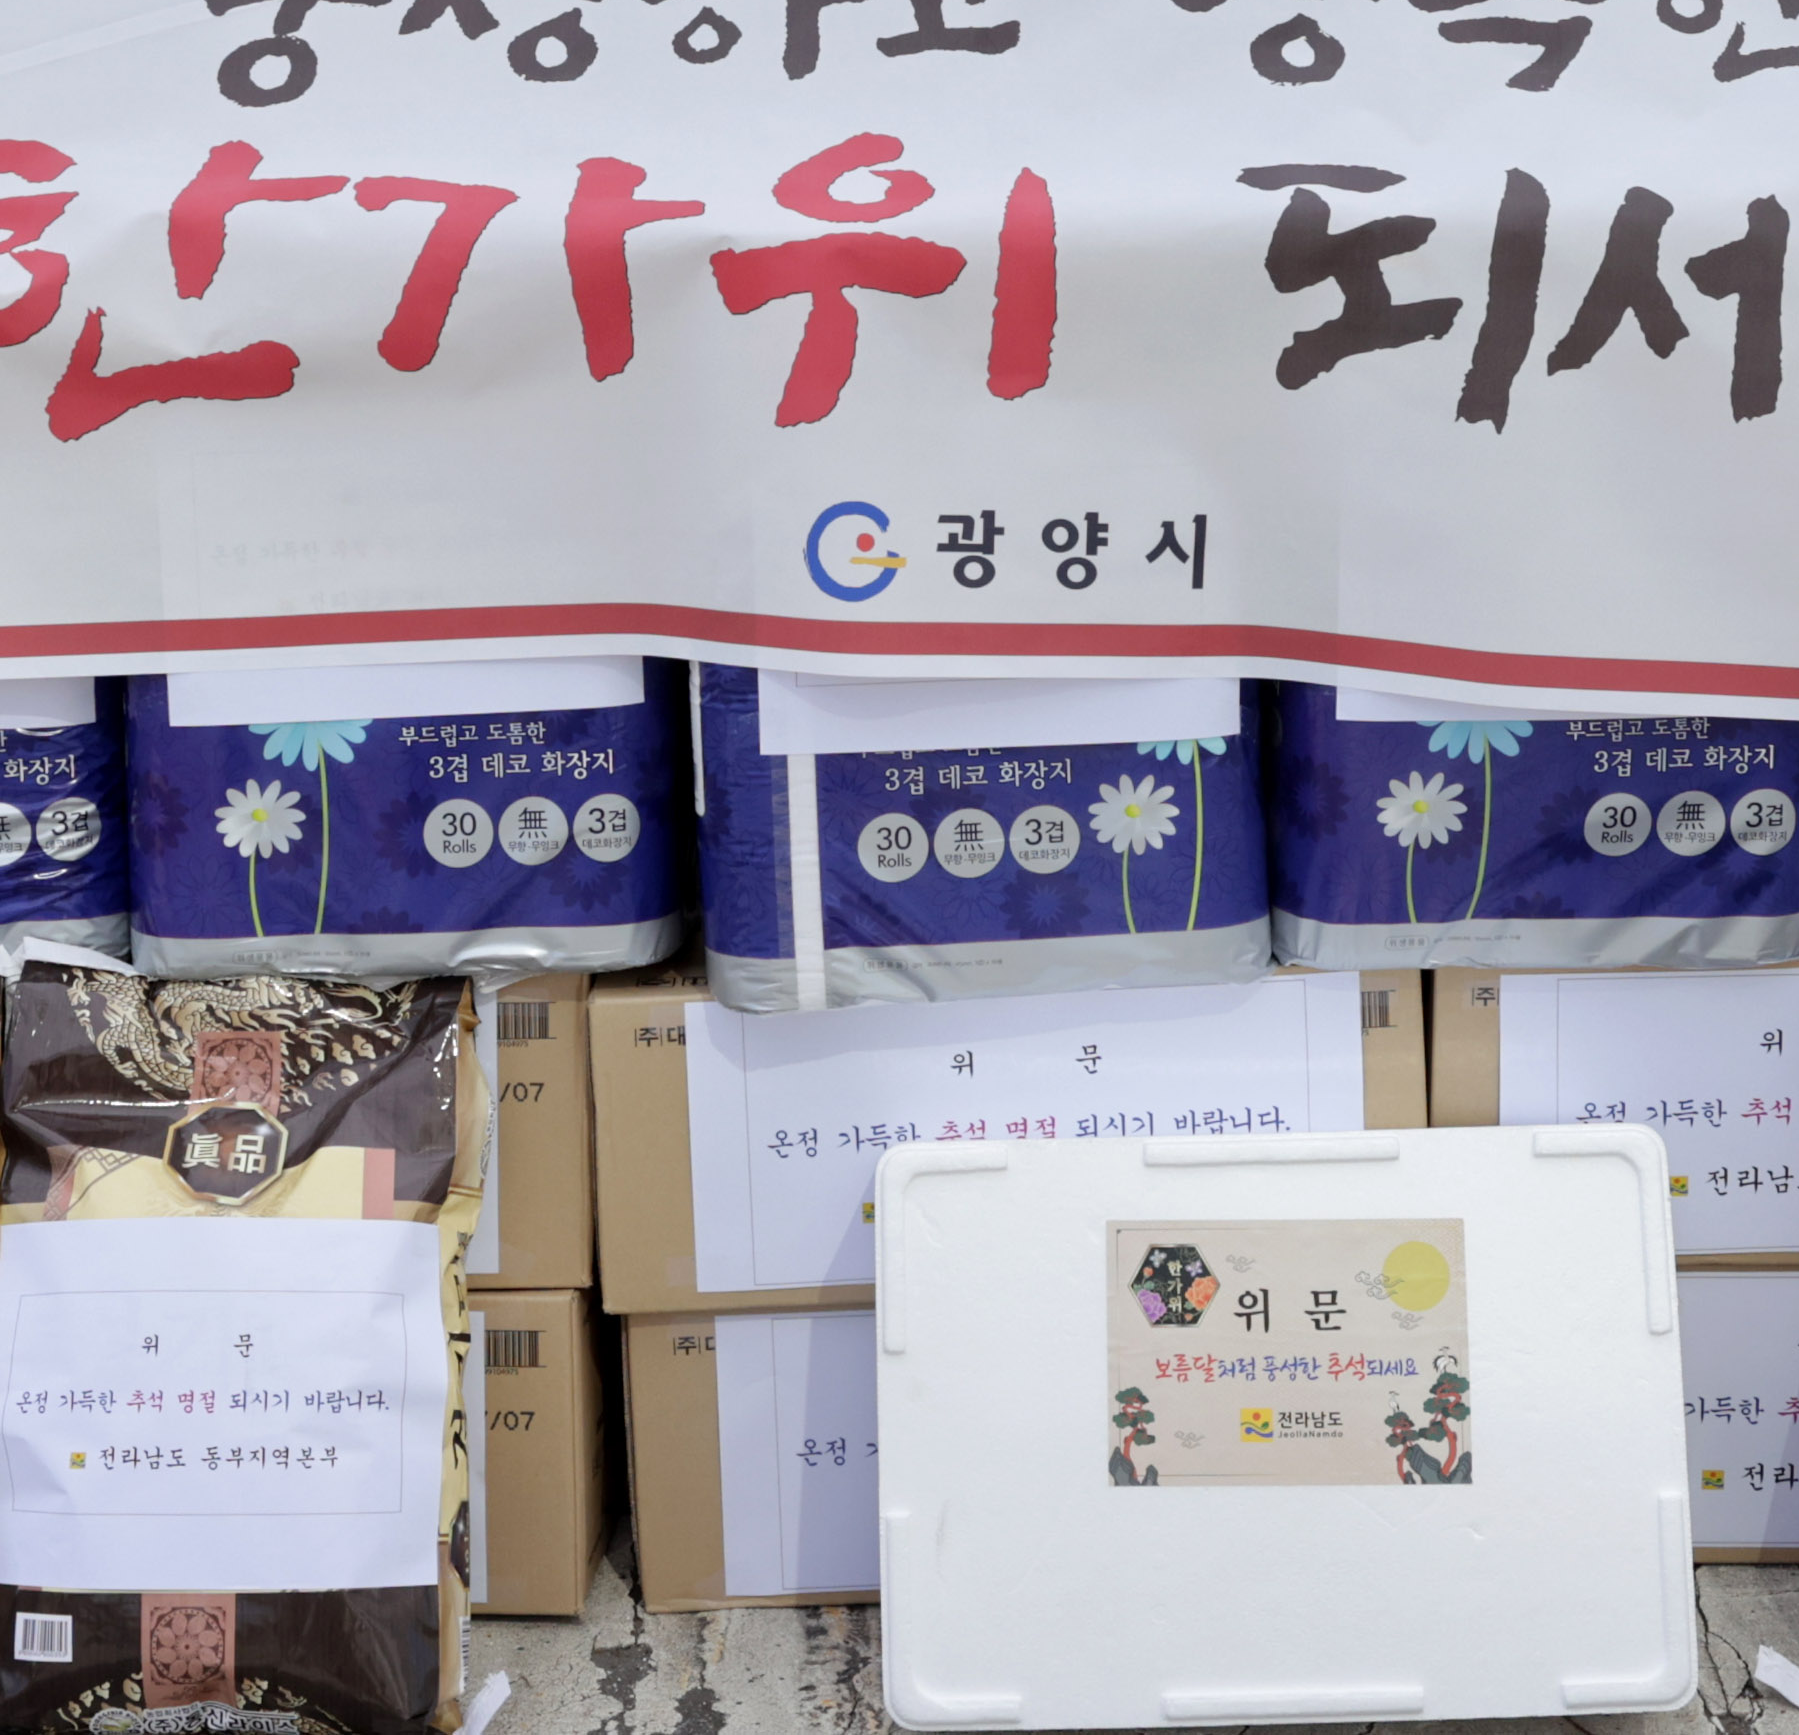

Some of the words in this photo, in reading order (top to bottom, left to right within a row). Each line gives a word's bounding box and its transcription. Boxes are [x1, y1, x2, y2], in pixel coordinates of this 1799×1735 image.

[933, 506, 1208, 594] 광양시
[399, 724, 479, 748] 부드럽고
[485, 720, 547, 745] 도톰한
[1565, 719, 1645, 743] 부드럽고
[1650, 716, 1711, 740] 도톰한
[3, 753, 78, 786] 화장지
[429, 753, 469, 784] 3겹
[481, 752, 532, 779] 데코
[541, 747, 615, 780] 화장지
[1593, 749, 1633, 778] 3겹
[1645, 747, 1695, 772] 데코
[1703, 743, 1777, 775] 화장지
[884, 766, 926, 795] 3겹
[938, 764, 989, 791] 데코
[998, 757, 1073, 790] 화장지
[51, 810, 89, 837] 3겹
[440, 811, 478, 837] 30
[517, 806, 548, 839] 無
[587, 807, 628, 835] 3겹
[1601, 805, 1638, 830] 30
[1675, 800, 1706, 831] 無
[1744, 801, 1785, 828] 3겹
[875, 826, 912, 851] 30
[953, 819, 985, 851] 無
[1024, 817, 1065, 846] 3겹
[1600, 829, 1635, 845] Rolls
[442, 838, 478, 855] Rolls
[877, 852, 913, 868] Rolls
[1644, 1097, 1728, 1127] 가득한
[1740, 1096, 1793, 1128] 추석
[767, 1128, 819, 1159] 온정
[1076, 1111, 1156, 1138] 되시기
[1174, 1104, 1292, 1136] 바랍니다.
[1154, 1353, 1257, 1384] 보름달처럼
[1261, 1354, 1323, 1382] 풍성한
[15, 1390, 50, 1414] 온정
[58, 1390, 118, 1414] 가득한
[126, 1389, 165, 1415] 추석
[177, 1389, 218, 1415] 명절
[228, 1388, 292, 1415] 되시기
[303, 1388, 391, 1415] 바랍니다.
[1684, 1396, 1765, 1425] 가득한
[1277, 1410, 1344, 1429] 전라남도
[98, 1445, 187, 1470] 전라남도
[200, 1444, 340, 1470] 동부지역본부
[796, 1437, 847, 1467] 온정
